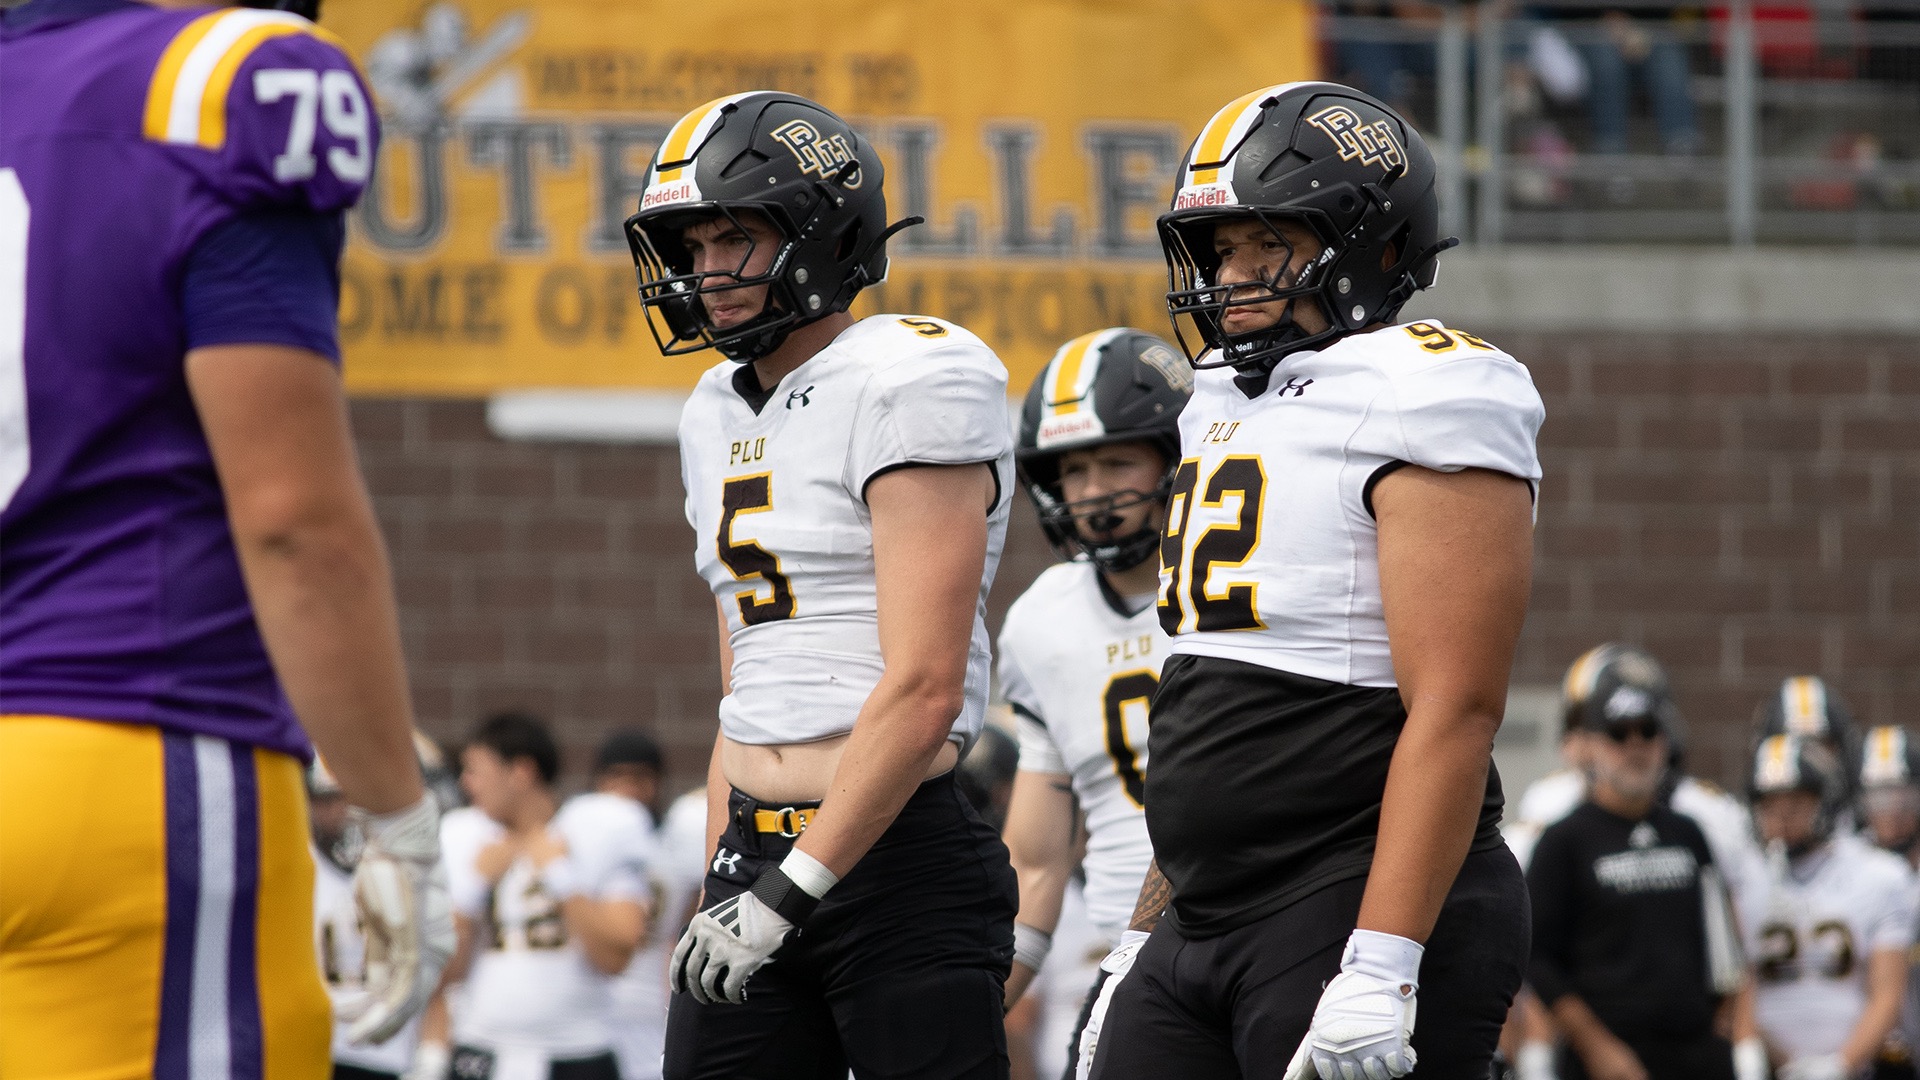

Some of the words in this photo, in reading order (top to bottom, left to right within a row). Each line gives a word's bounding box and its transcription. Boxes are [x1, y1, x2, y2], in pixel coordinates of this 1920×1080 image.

[253, 68, 371, 182] 79
[771, 119, 863, 190] PLU
[1306, 105, 1409, 178] PLU
[644, 184, 690, 208] Riddell
[1177, 189, 1227, 210] Riddell
[338, 266, 506, 342] OME
[729, 436, 768, 466] PLU
[1200, 421, 1241, 445] PLU
[716, 470, 798, 626] 5
[1157, 454, 1270, 637] 92
[1106, 634, 1152, 665] PLU
